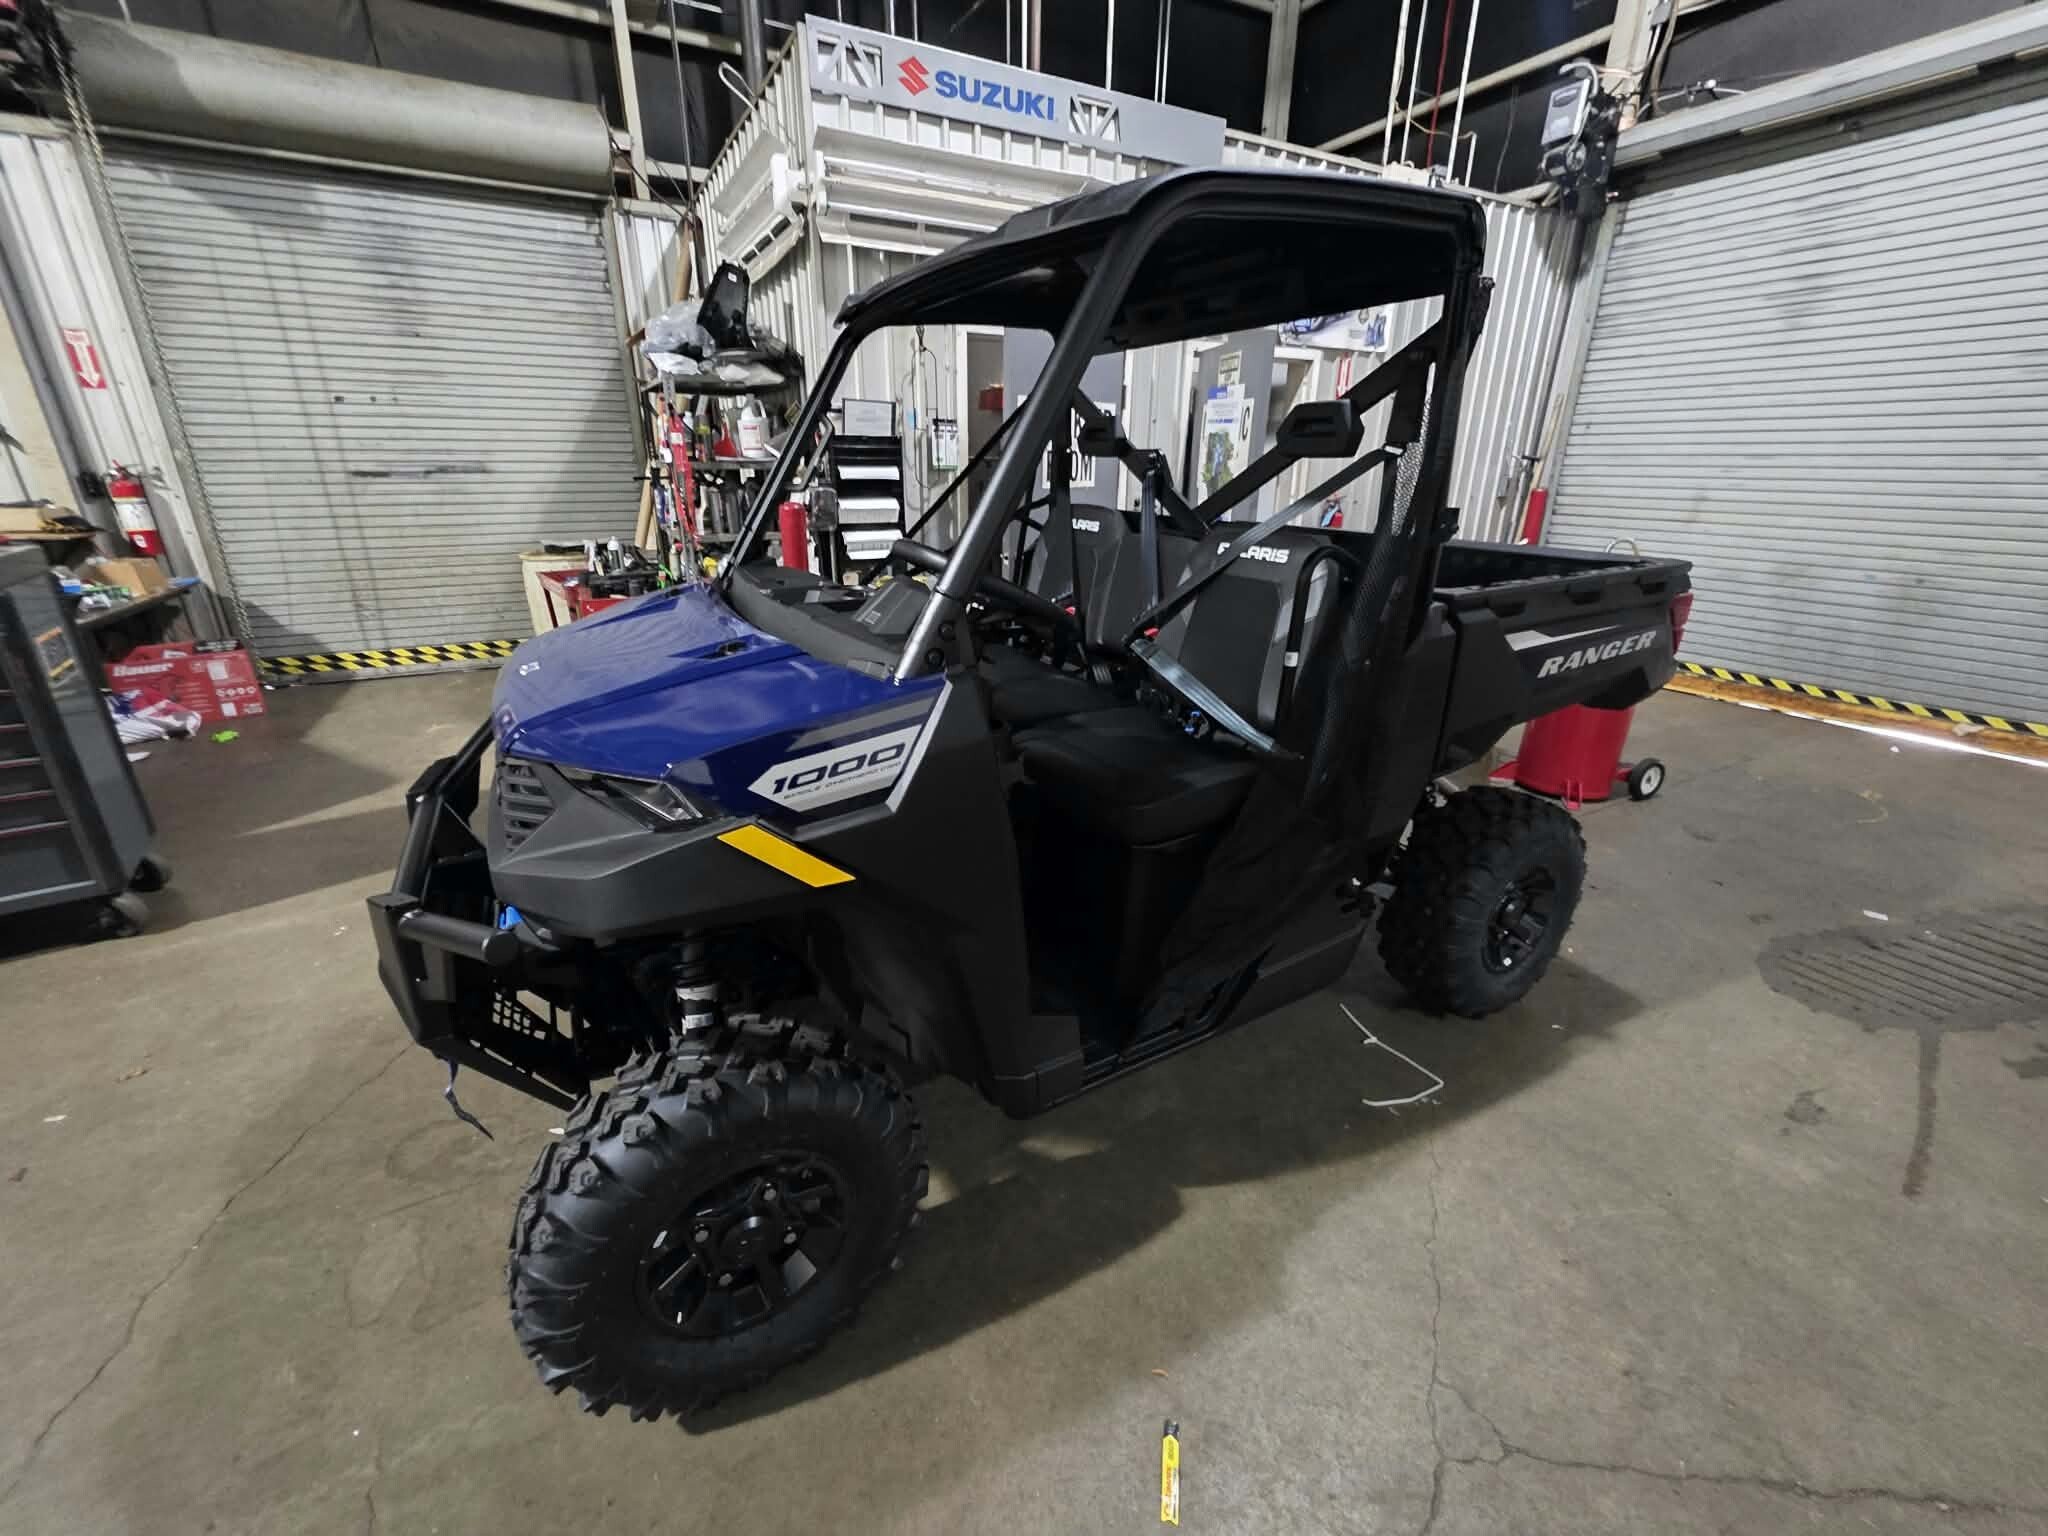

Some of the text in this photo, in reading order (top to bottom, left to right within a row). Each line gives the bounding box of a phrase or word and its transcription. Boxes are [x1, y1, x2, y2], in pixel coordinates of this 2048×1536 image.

[935, 70, 1055, 120] SUZUKI
[1071, 517, 1100, 532] LARIS
[1217, 541, 1290, 563] PARIS
[1537, 631, 1657, 678] RANGER
[773, 743, 905, 794] 1000
